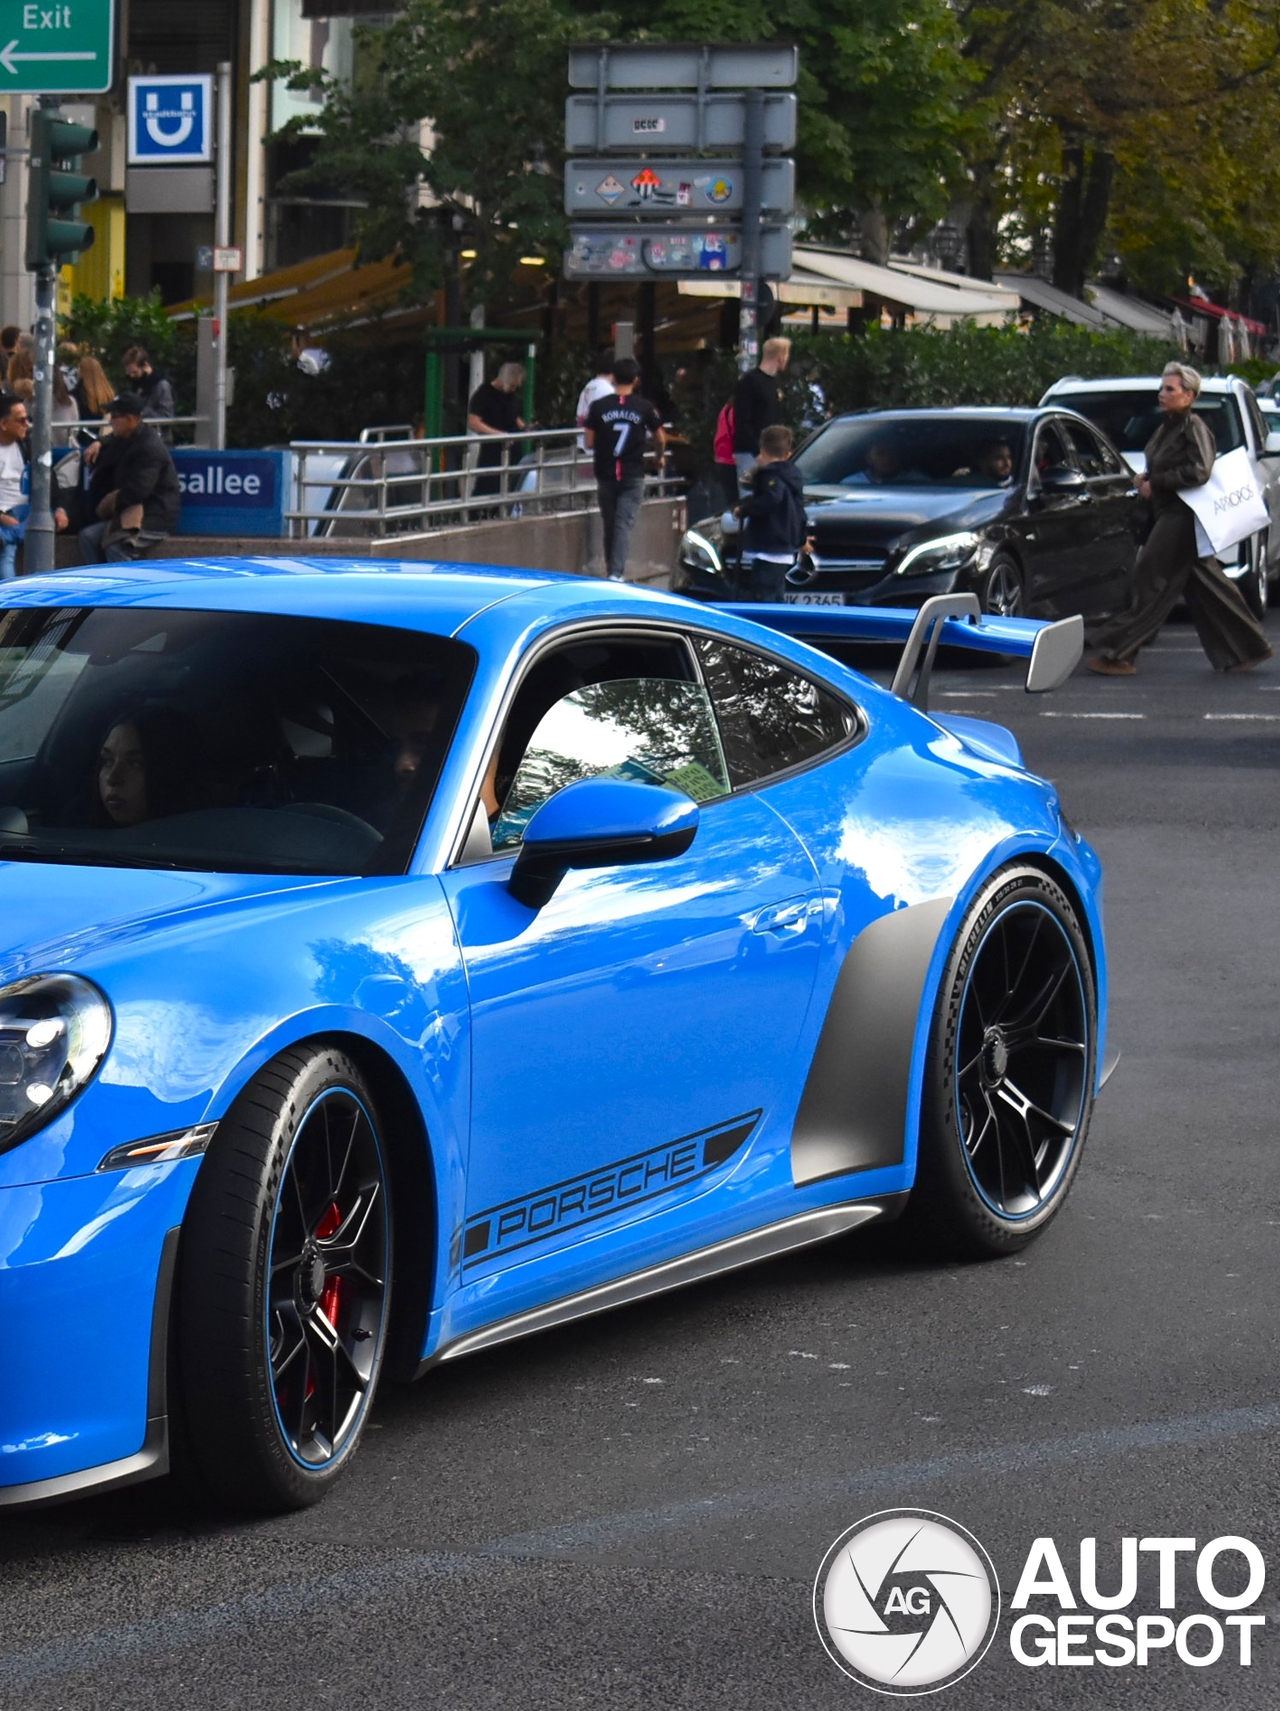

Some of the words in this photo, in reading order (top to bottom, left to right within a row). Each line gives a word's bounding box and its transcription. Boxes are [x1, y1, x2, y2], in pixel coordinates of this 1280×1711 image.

[23, 5, 71, 29] Exit
[146, 92, 193, 147] U
[601, 409, 641, 424] RONALDO
[612, 422, 630, 457] 7
[958, 900, 995, 976] MICHELIN
[496, 1142, 698, 1245] PORSCHE
